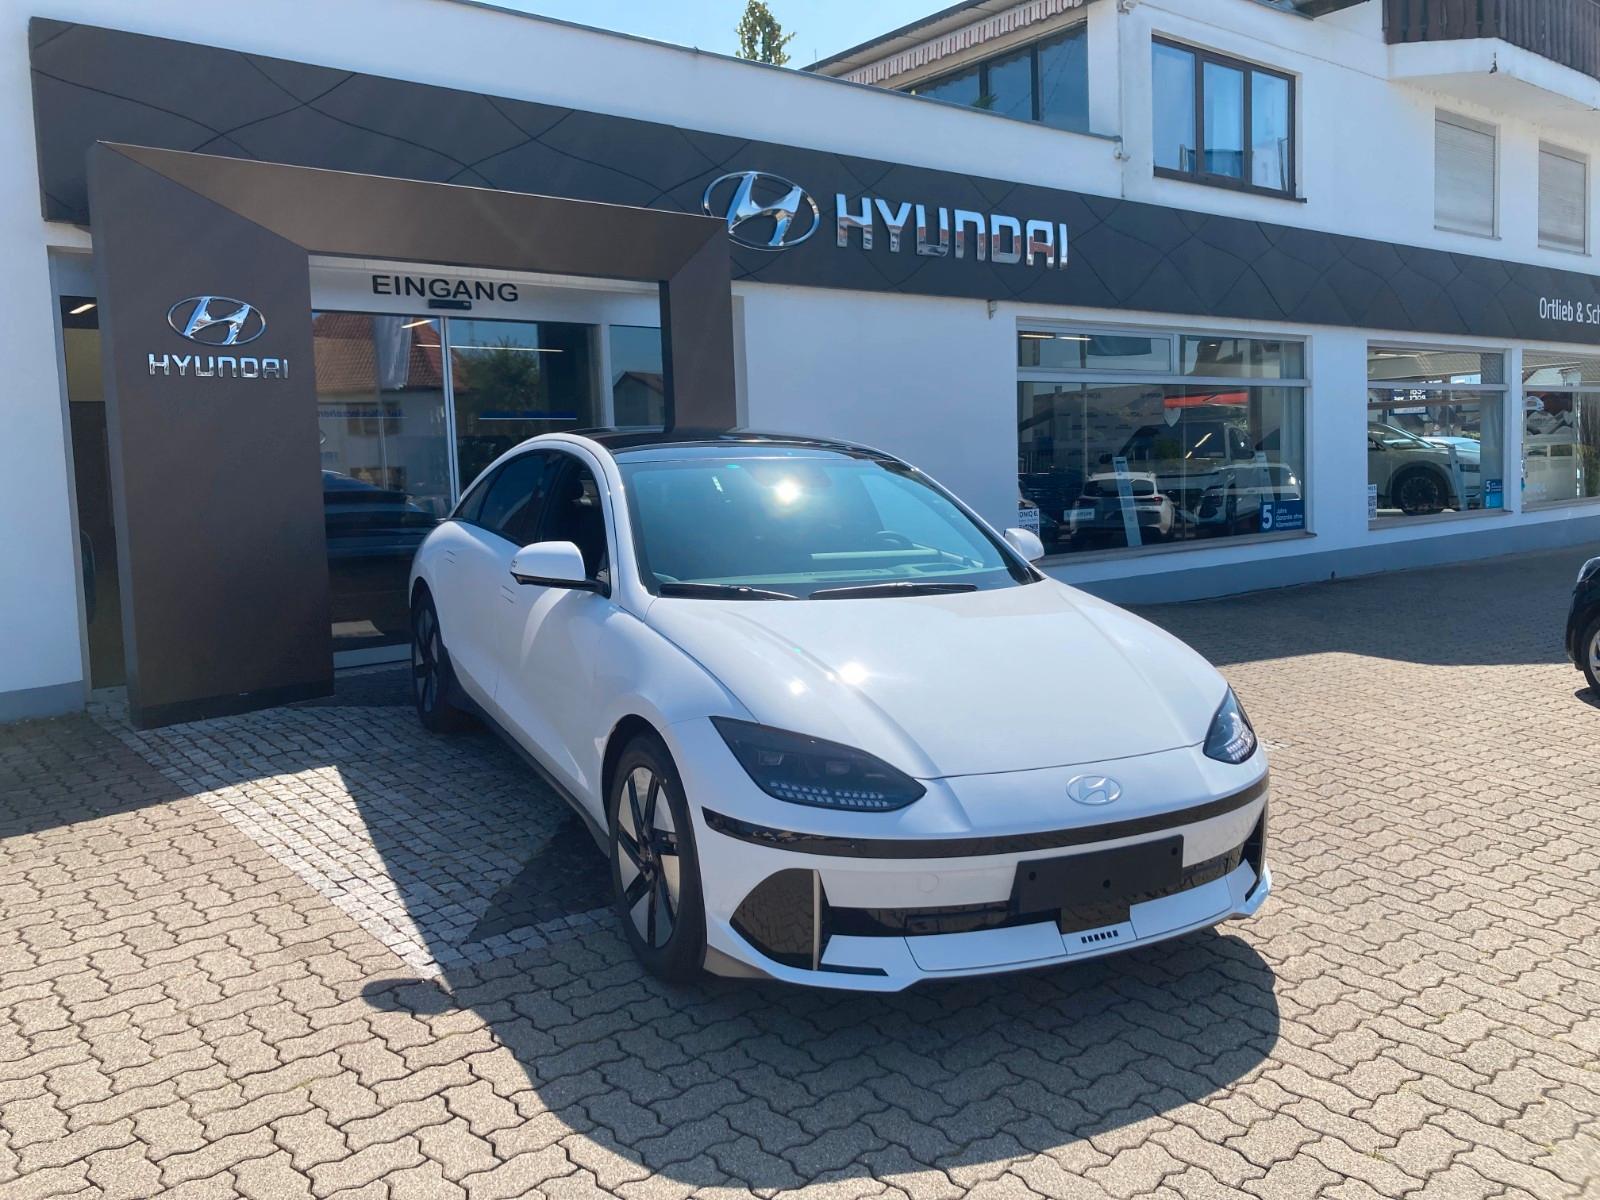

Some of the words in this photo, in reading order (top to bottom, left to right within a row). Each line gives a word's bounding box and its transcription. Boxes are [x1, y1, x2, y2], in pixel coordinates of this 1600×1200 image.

[836, 193, 1068, 270] HYUNDAI
[372, 275, 519, 302] EINGANG
[1540, 297, 1574, 322] Ortlieb
[1576, 301, 1584, 323] &
[148, 353, 289, 379] HYUNDAI
[1262, 504, 1273, 529] 5
